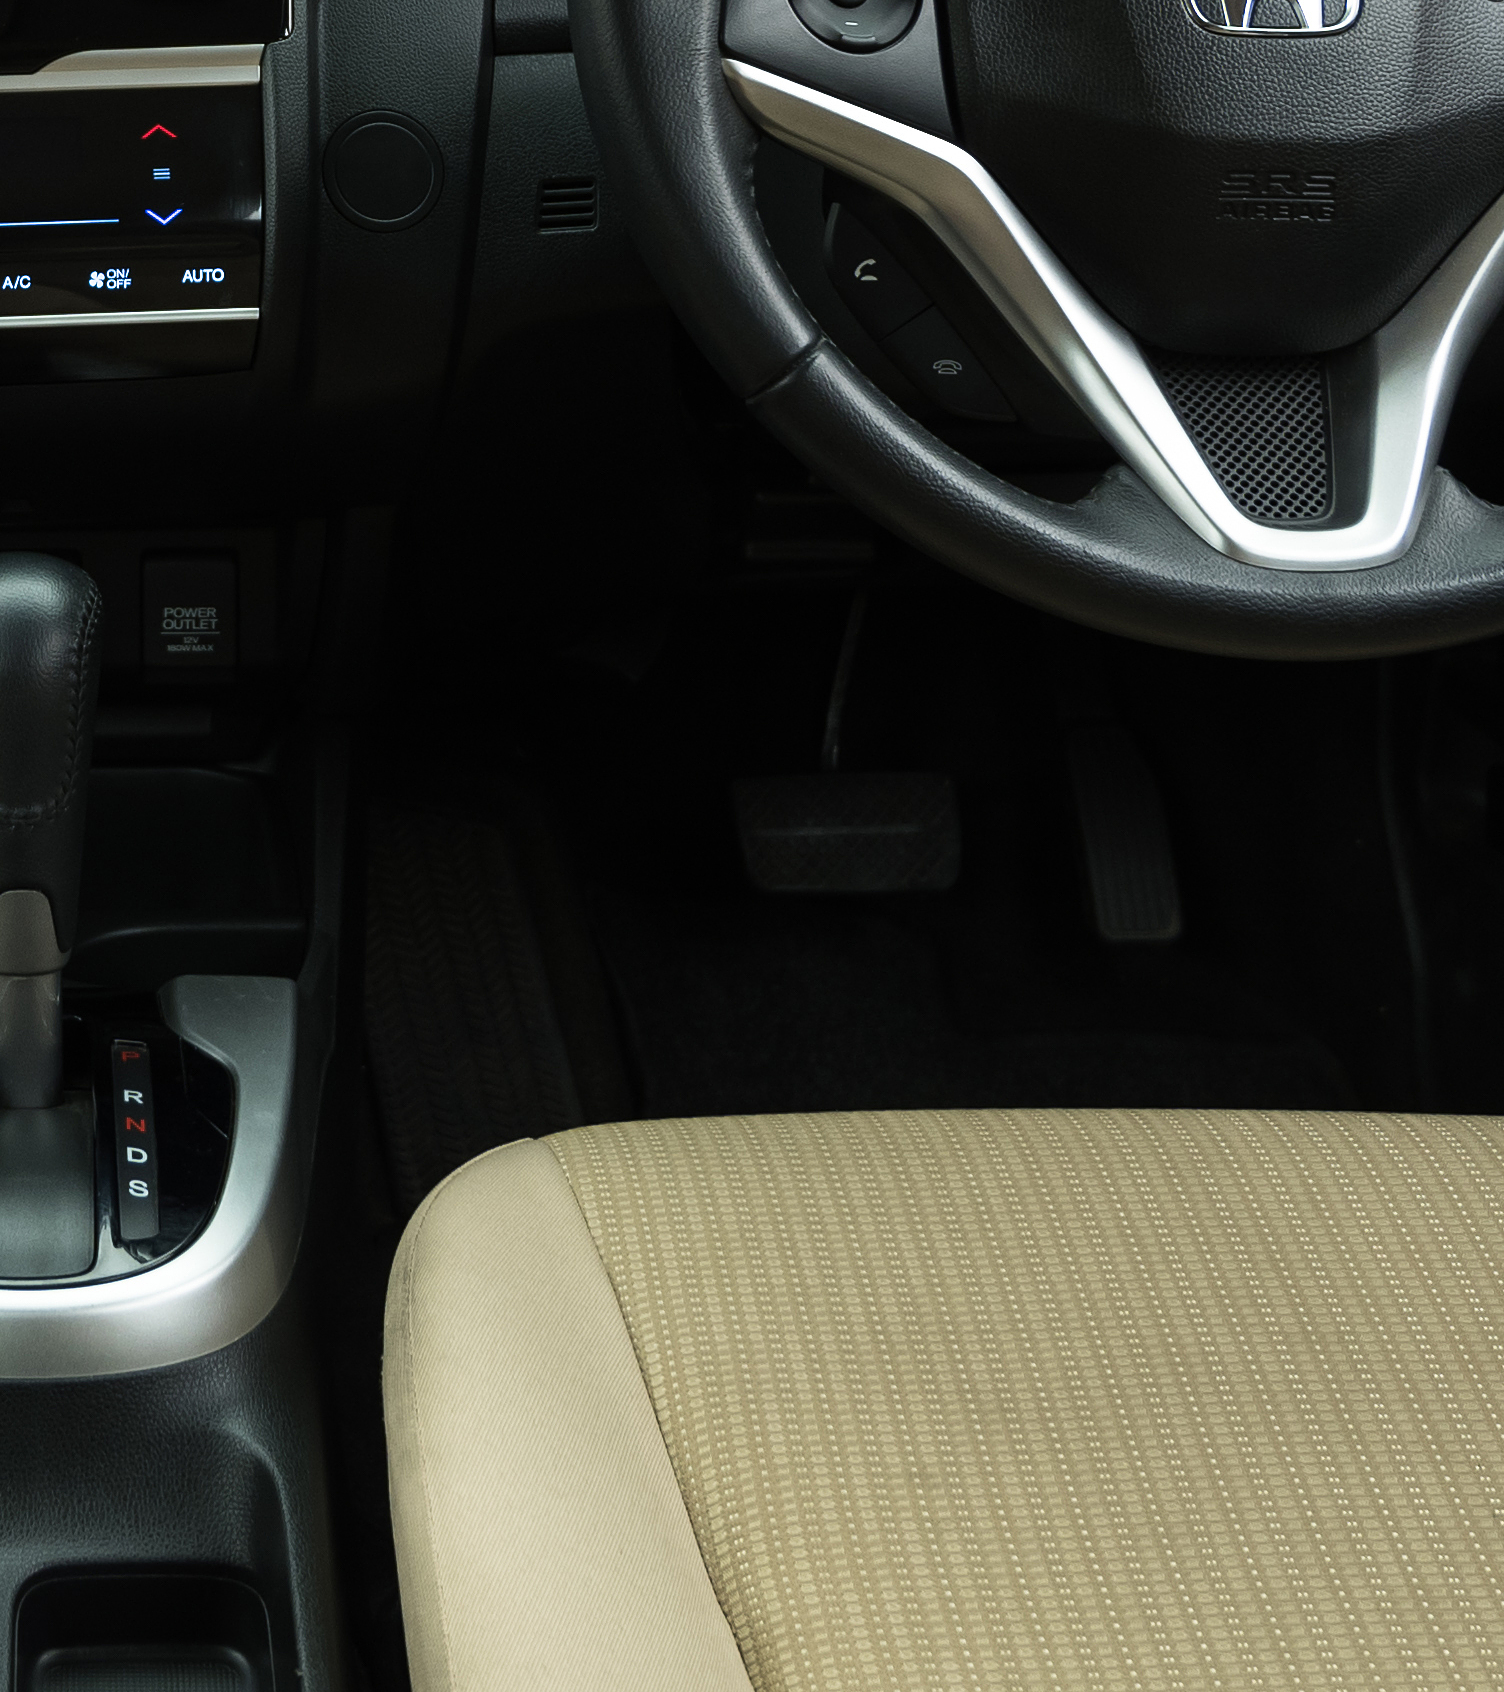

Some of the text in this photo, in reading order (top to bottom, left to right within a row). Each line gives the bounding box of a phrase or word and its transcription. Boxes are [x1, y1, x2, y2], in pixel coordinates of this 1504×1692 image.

[1221, 171, 1336, 196] SRS
[106, 268, 130, 281] ON/
[182, 268, 225, 283] AUTO
[2, 274, 32, 290] A/C
[106, 278, 132, 290] OFF
[164, 607, 217, 618] POWER
[162, 619, 218, 630] OUTLET
[121, 1051, 140, 1062] P
[124, 1090, 144, 1104] R
[126, 1117, 146, 1132] N
[126, 1147, 148, 1163] D
[128, 1180, 149, 1197] S
